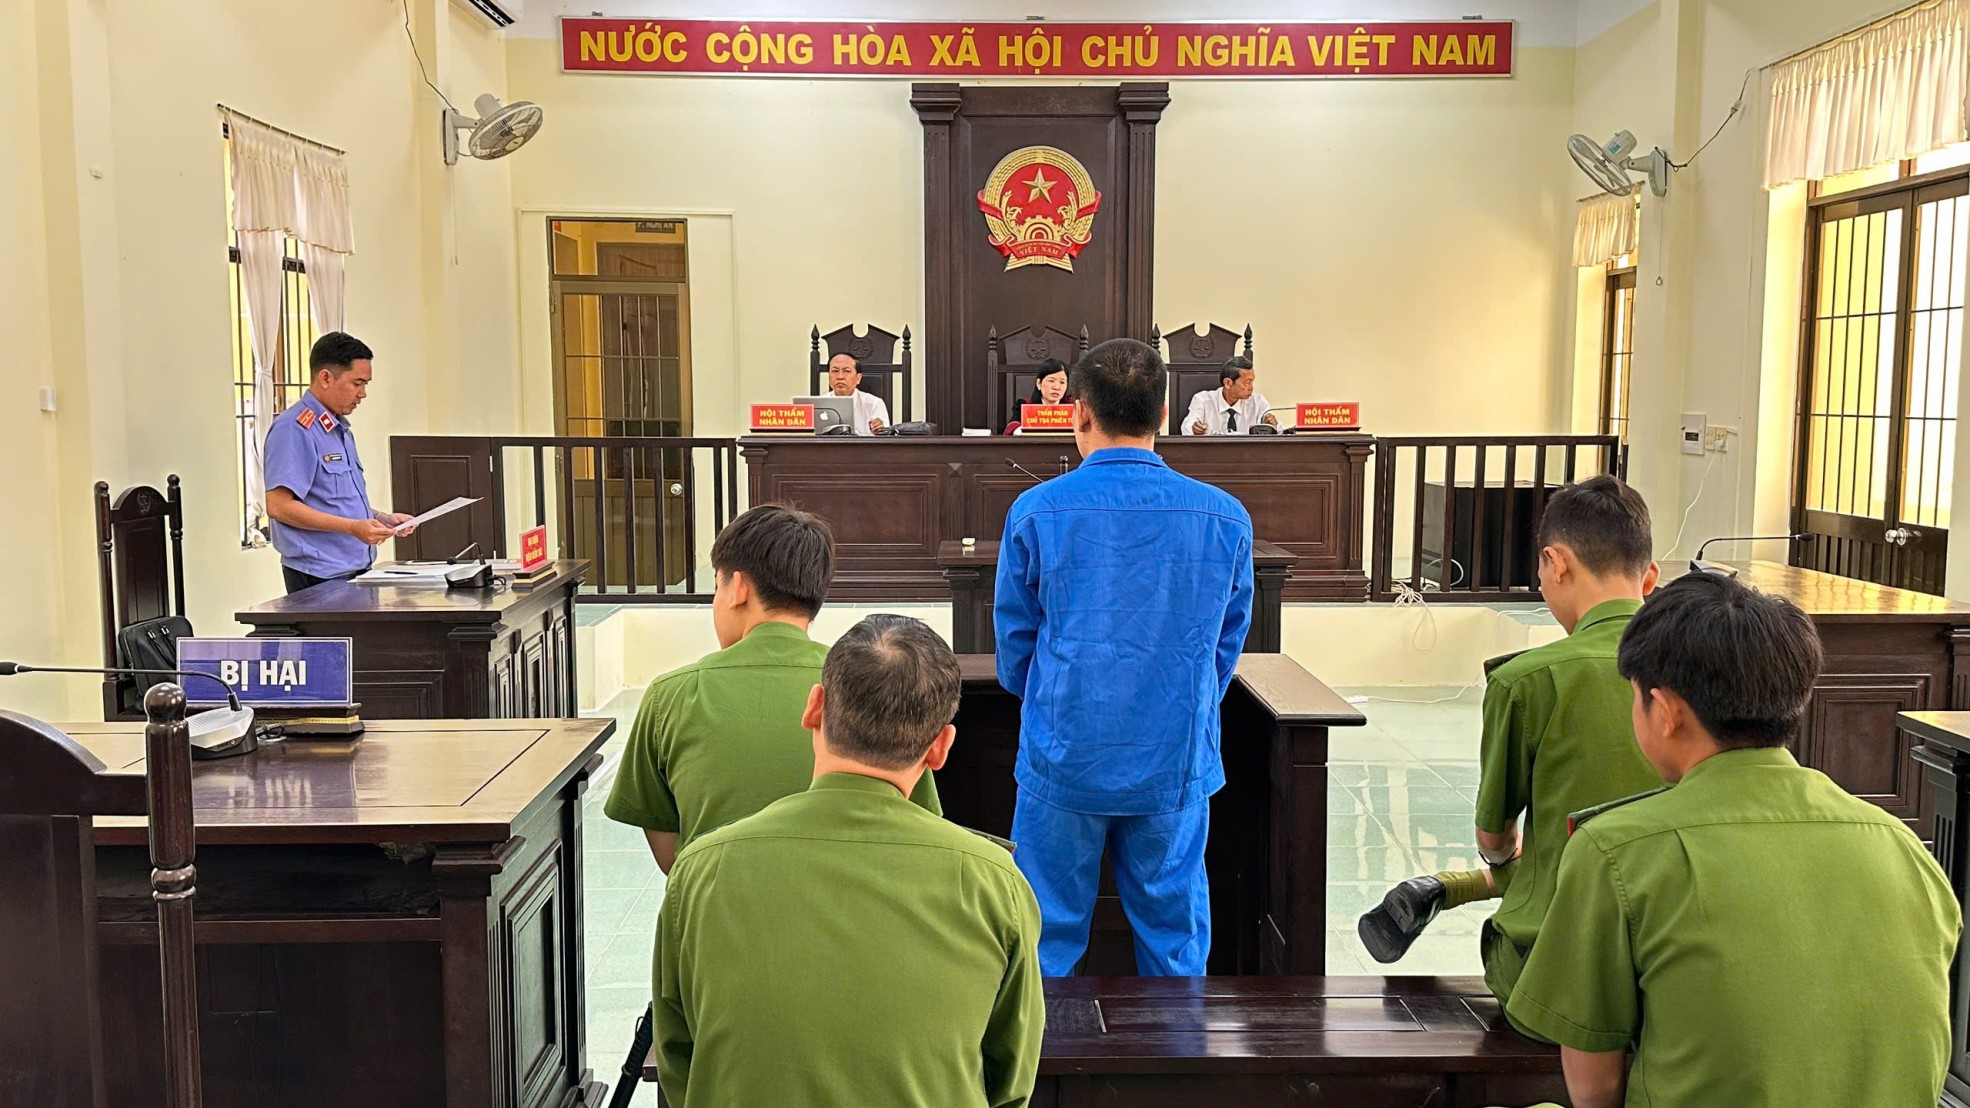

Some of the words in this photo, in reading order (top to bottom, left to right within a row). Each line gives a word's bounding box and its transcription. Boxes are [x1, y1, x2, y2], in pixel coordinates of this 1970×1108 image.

[580, 22, 688, 63] NƯỚC
[705, 25, 814, 71] CỘNG
[832, 25, 912, 66] HÒA
[928, 26, 981, 67] XÃ
[998, 27, 1062, 74] HỘI
[1081, 24, 1159, 68] CHỦ
[1177, 27, 1296, 68] NGHĨA
[1307, 26, 1396, 73] VIỆT
[1411, 34, 1496, 66] NAM
[1019, 246, 1037, 255] VIỆT
[1041, 246, 1059, 255] NAM
[760, 409, 776, 418] HỘI
[779, 407, 805, 417] THẨM
[1305, 407, 1321, 417] HỘI
[1323, 406, 1350, 416] THẨM
[759, 417, 786, 426] NHÂN
[787, 417, 806, 426] DÂN
[1304, 415, 1329, 425] NHÂN
[1331, 415, 1351, 424] DÂN
[220, 660, 249, 692] BỊ
[259, 660, 307, 692] HẠI
